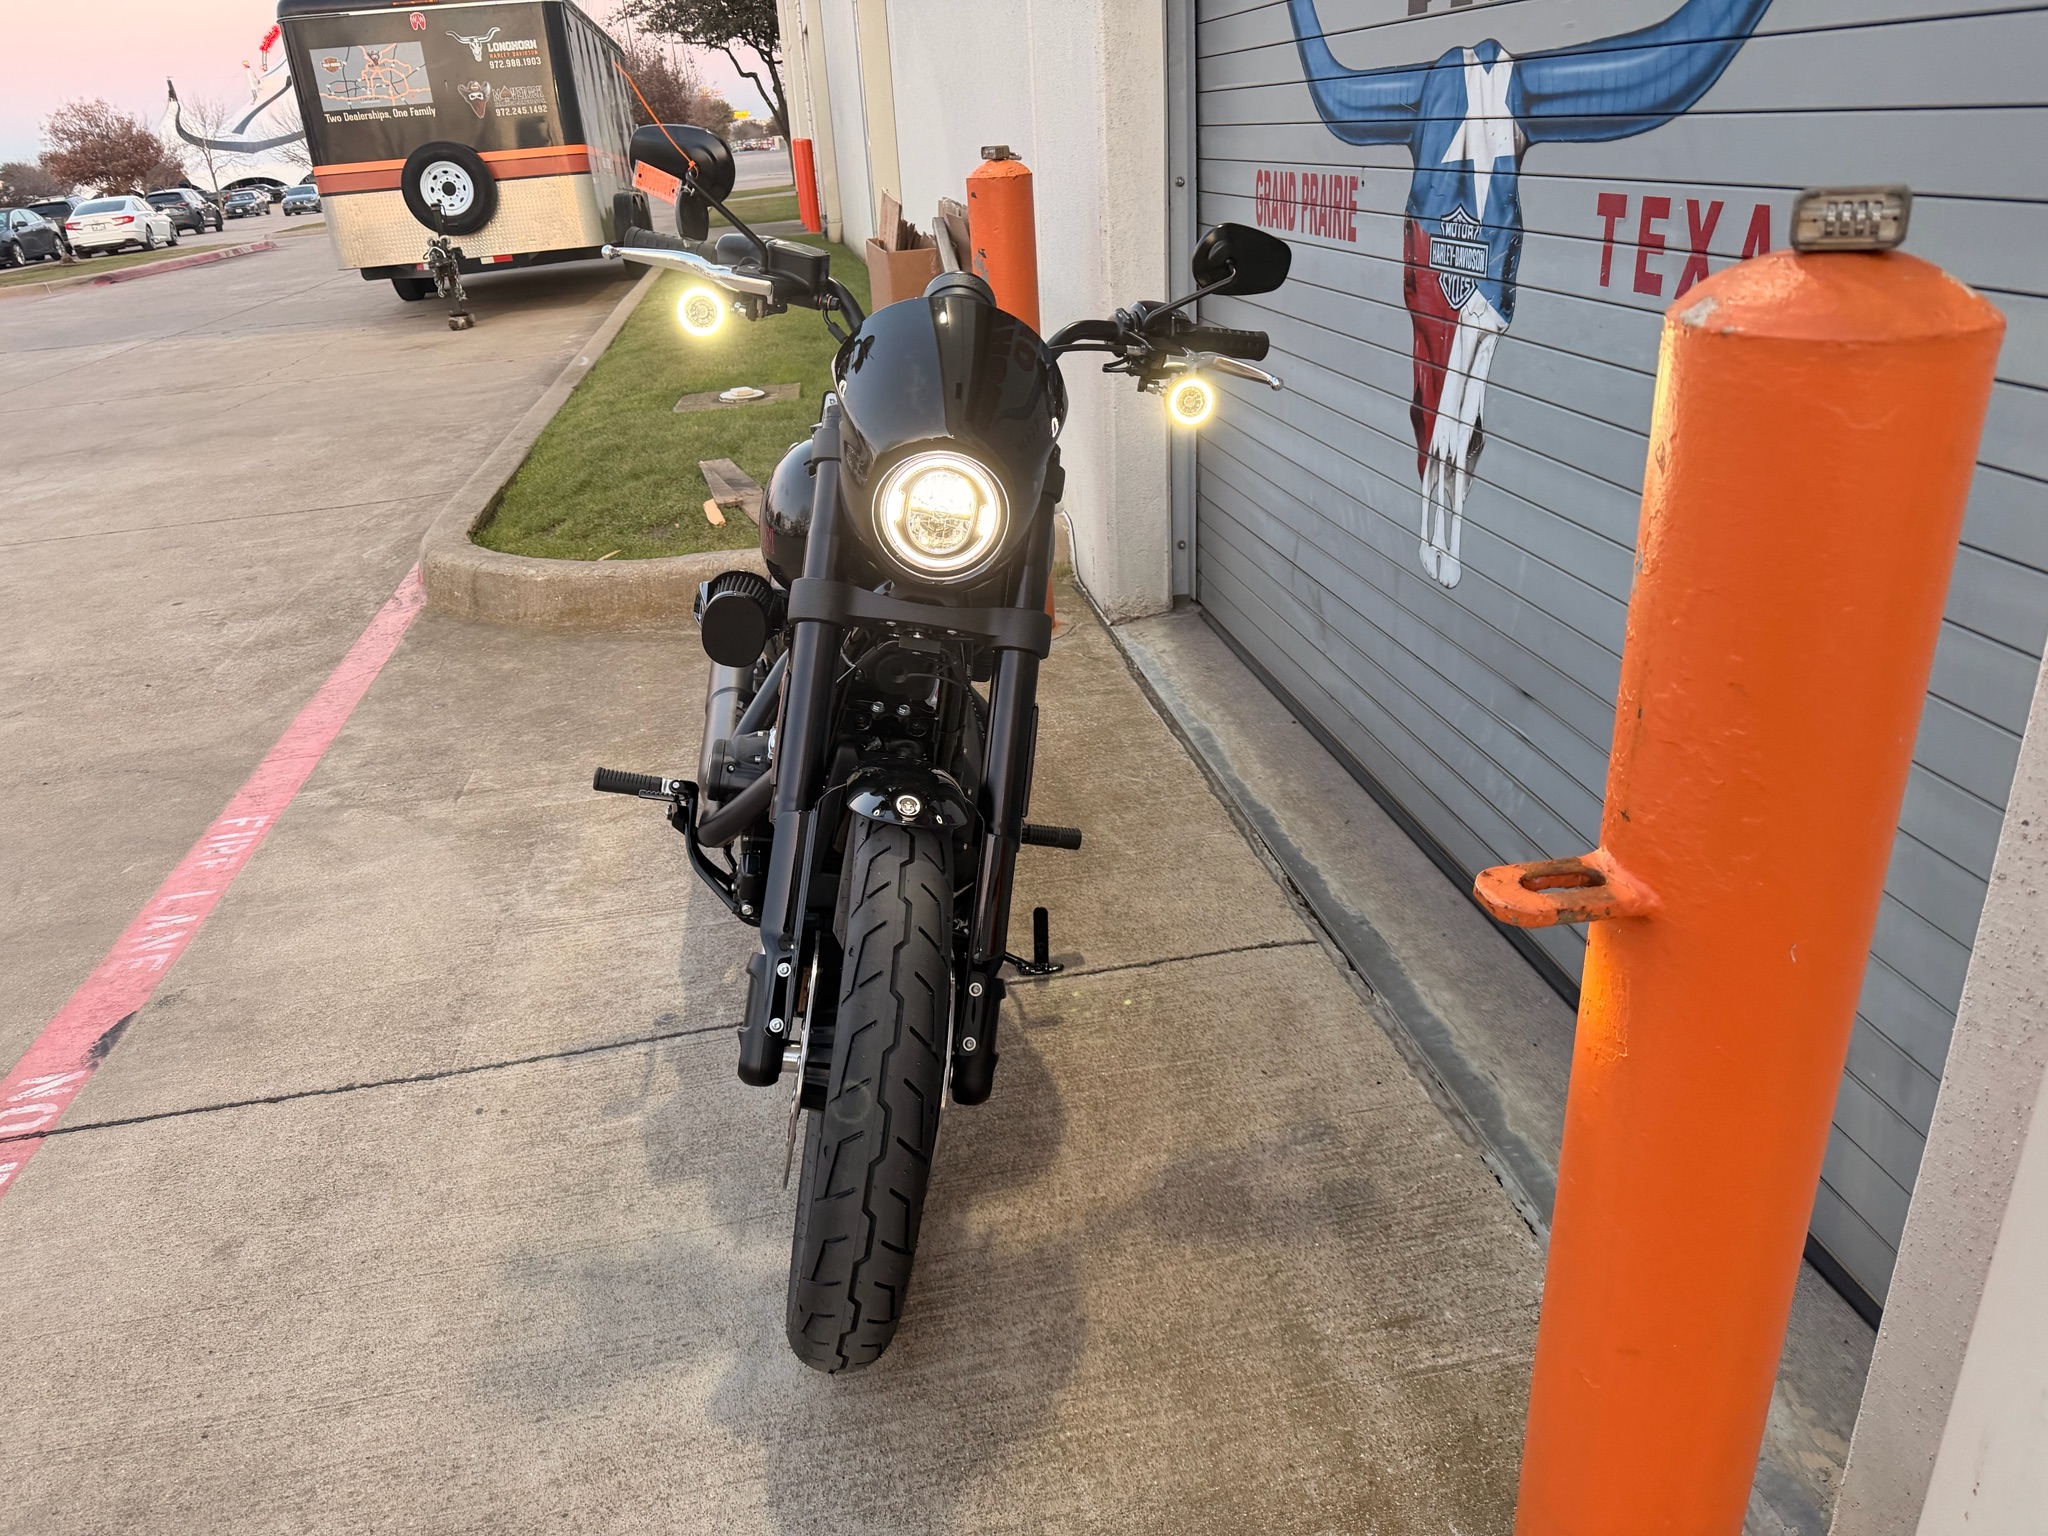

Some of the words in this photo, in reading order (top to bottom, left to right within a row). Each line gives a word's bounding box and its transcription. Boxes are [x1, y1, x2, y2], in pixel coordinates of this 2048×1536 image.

[487, 40, 537, 52] LONGHORN
[489, 57, 541, 69] 972.988.1903
[324, 113, 342, 123] Two
[343, 110, 392, 122] Dealerships,
[392, 108, 408, 118] One
[410, 106, 436, 118] Family
[496, 105, 548, 117] 972.245.1492
[1256, 169, 1296, 232] GRAND
[1302, 172, 1359, 243] PRAIRIE
[1445, 222, 1475, 240] MOTOR
[1432, 242, 1485, 271] HARLEY-DAVIDSON
[1597, 192, 1771, 301] TEXA
[1443, 272, 1471, 304] CYCLES
[190, 815, 270, 872] FIRE
[120, 889, 218, 972] LANE
